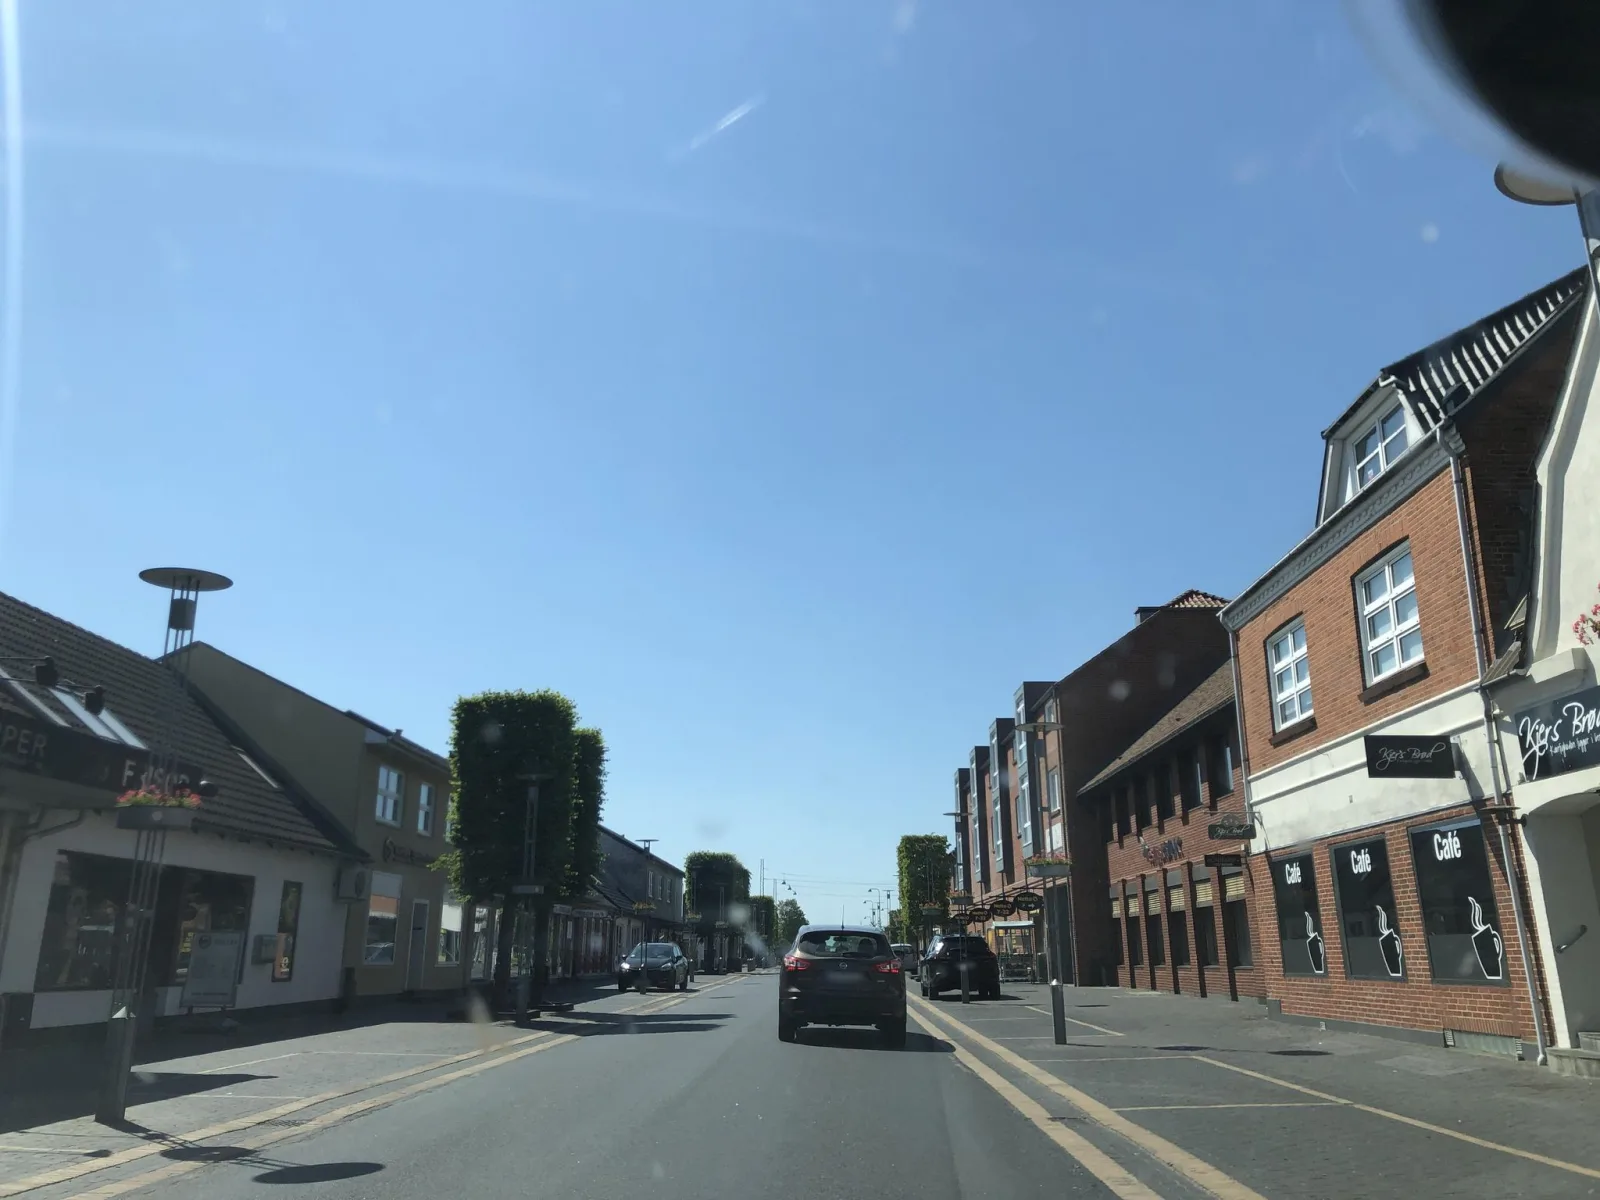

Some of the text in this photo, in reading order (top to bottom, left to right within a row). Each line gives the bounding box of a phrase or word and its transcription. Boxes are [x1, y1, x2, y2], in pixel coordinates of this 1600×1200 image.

[0, 722, 48, 758] PER
[1434, 830, 1462, 861] Café
[1285, 862, 1302, 886] Café
[1350, 848, 1372, 875] Café
